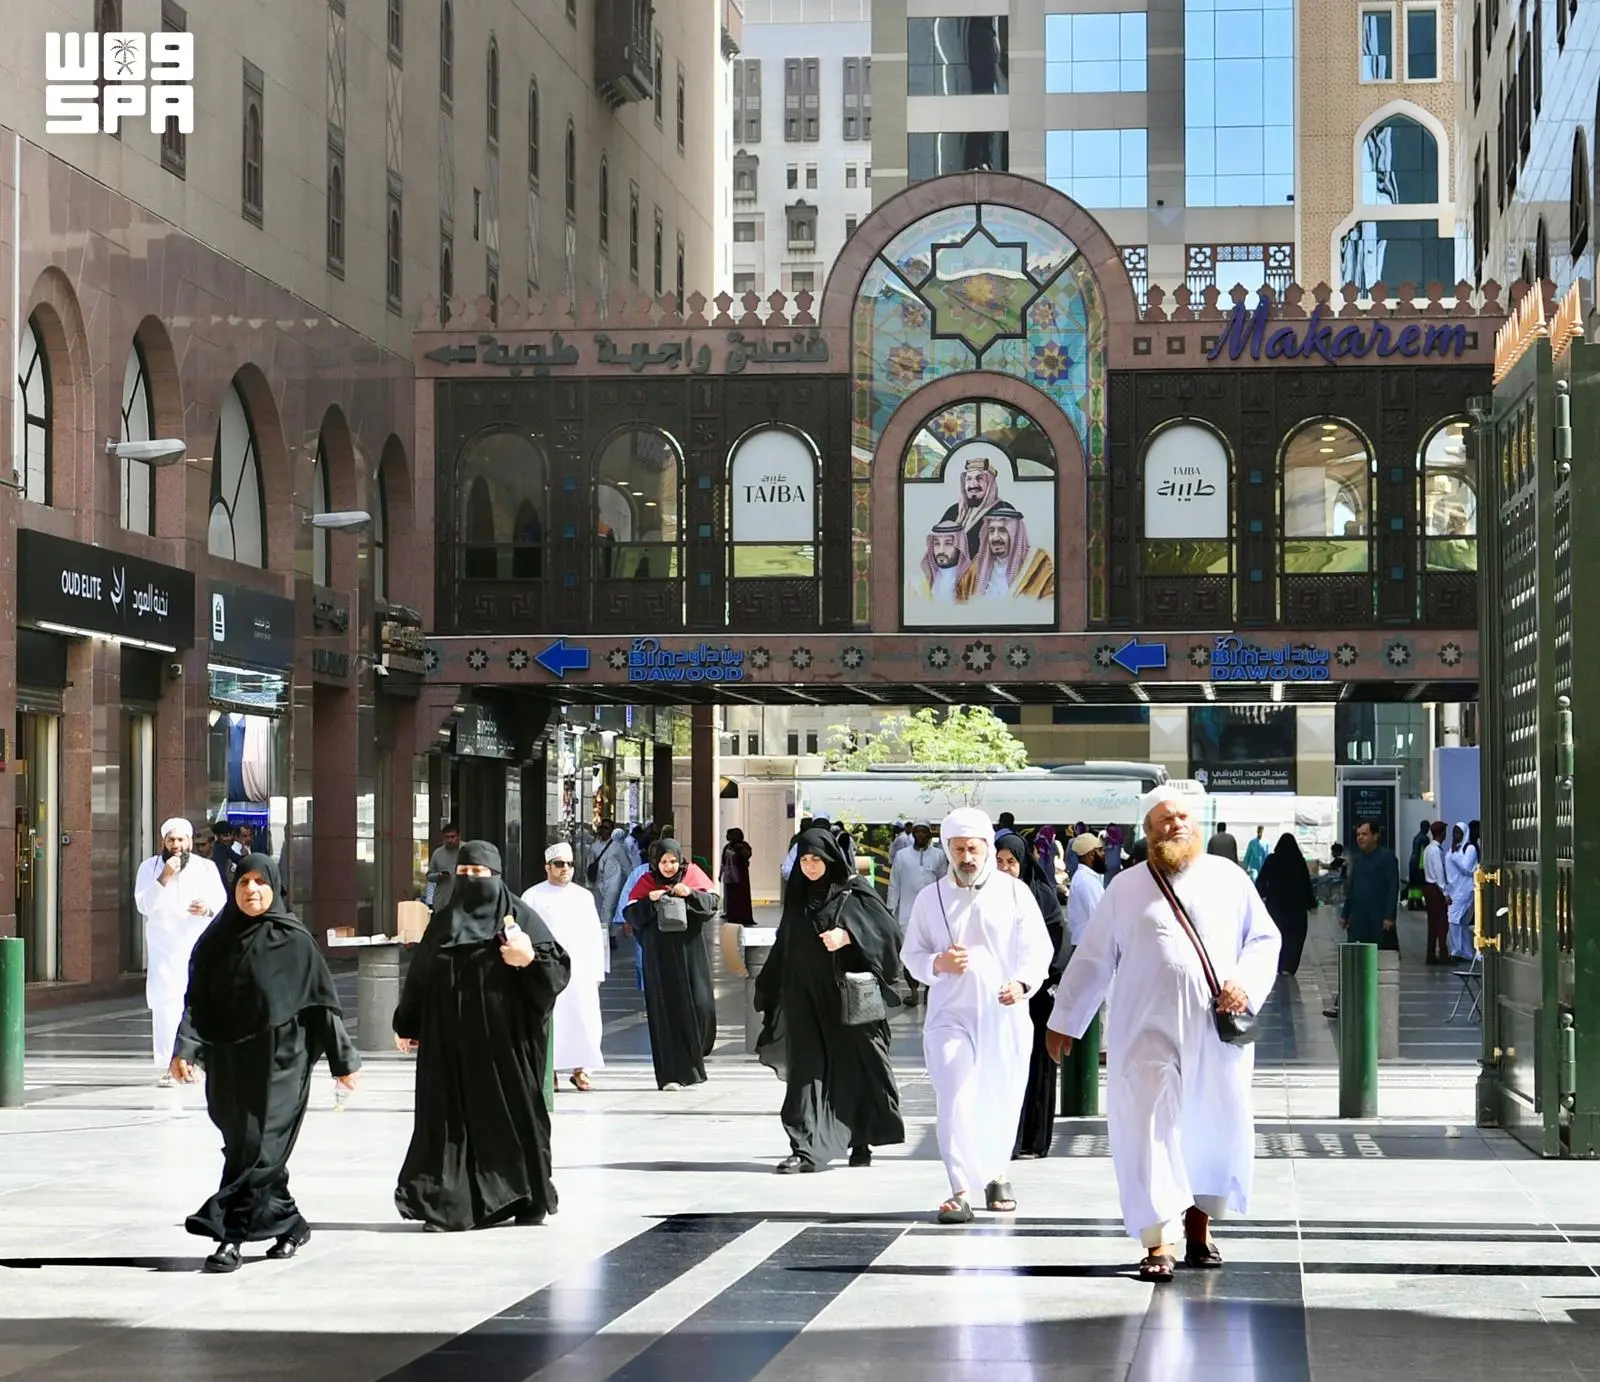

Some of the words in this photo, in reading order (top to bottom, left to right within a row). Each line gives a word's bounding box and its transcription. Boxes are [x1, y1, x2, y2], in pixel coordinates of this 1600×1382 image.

[1207, 294, 1467, 367] Makarem
[478, 332, 580, 378] طيبة
[594, 332, 712, 374] واجهة
[725, 328, 829, 374] فندق
[1173, 466, 1201, 476] TAIBA
[743, 485, 805, 503] TAIBA
[1157, 479, 1216, 502] طيبة
[61, 569, 81, 596] OUD
[81, 574, 102, 601] ELITE
[132, 583, 153, 616] العود
[628, 667, 744, 681] DAWOOD
[1211, 665, 1329, 680] DAWOOD
